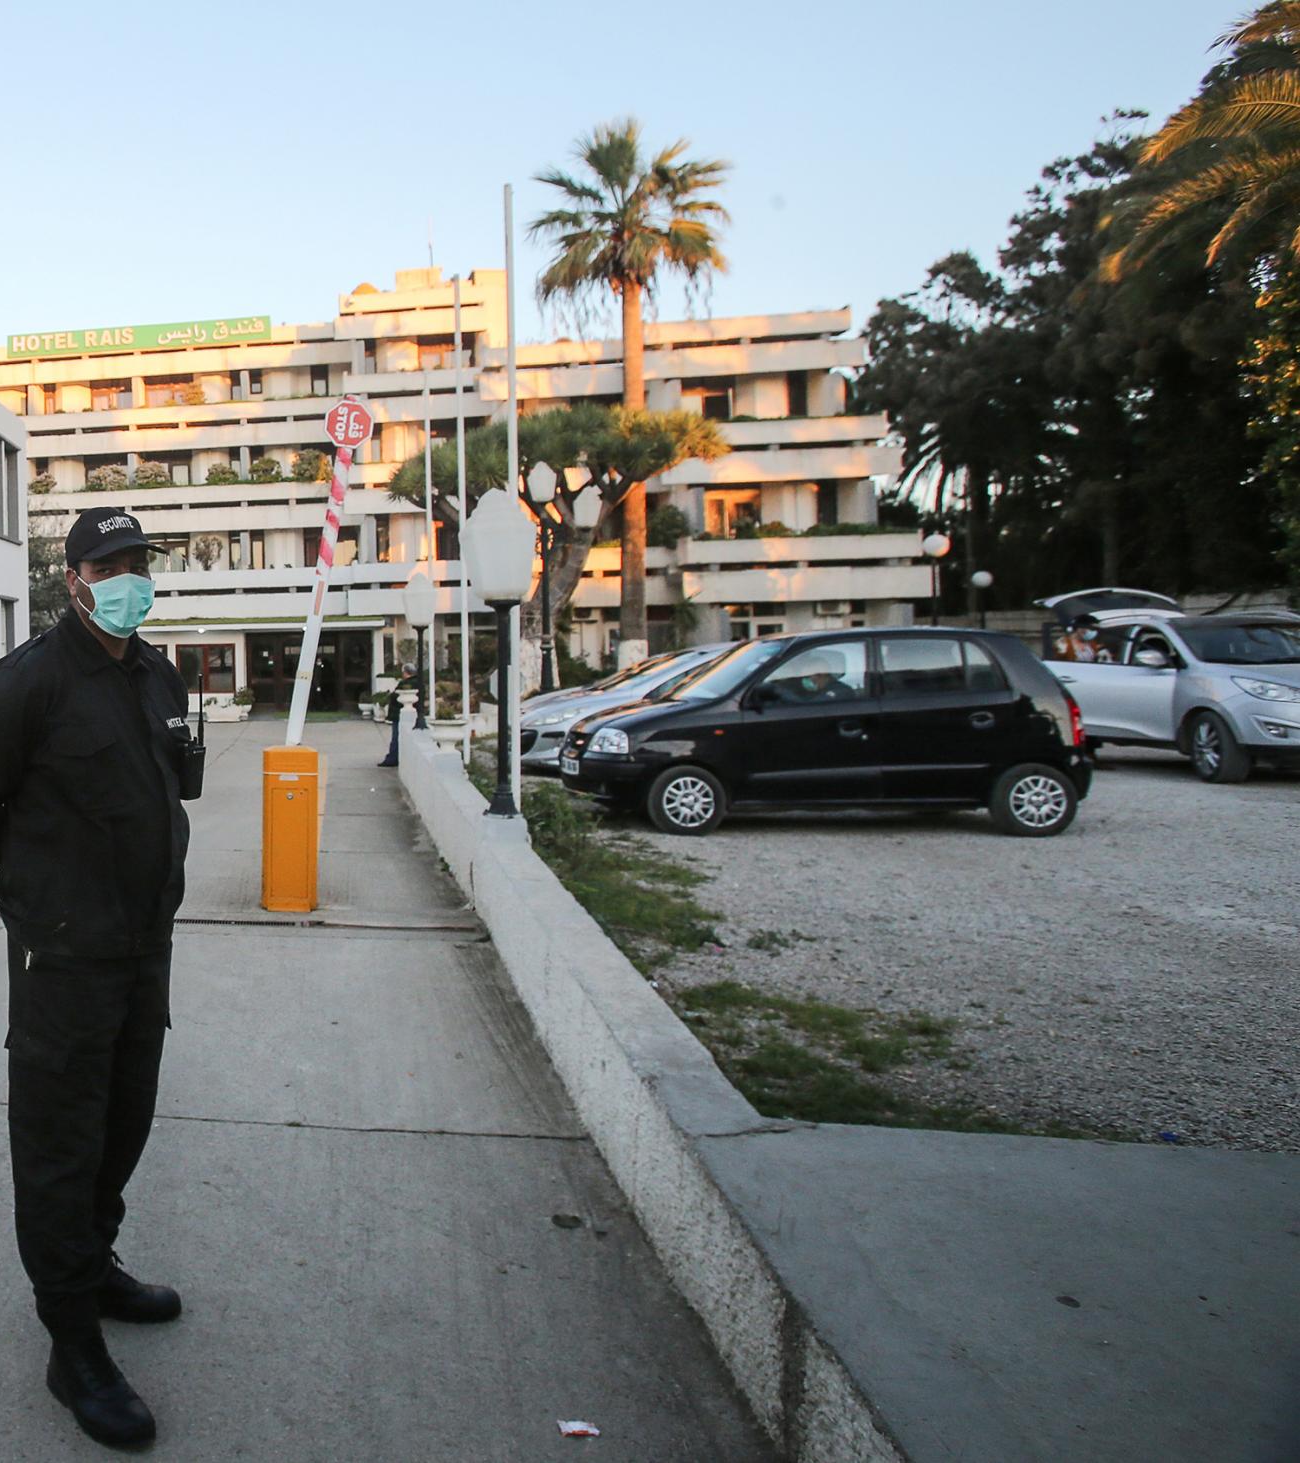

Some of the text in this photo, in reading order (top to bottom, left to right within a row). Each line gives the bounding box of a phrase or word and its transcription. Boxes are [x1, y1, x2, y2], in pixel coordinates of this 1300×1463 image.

[12, 327, 135, 352] HOTEL RAIS
[157, 316, 265, 344] فندق رايس
[334, 406, 349, 441] STOP
[348, 410, 364, 439] قف
[165, 716, 185, 729] HOTEL
